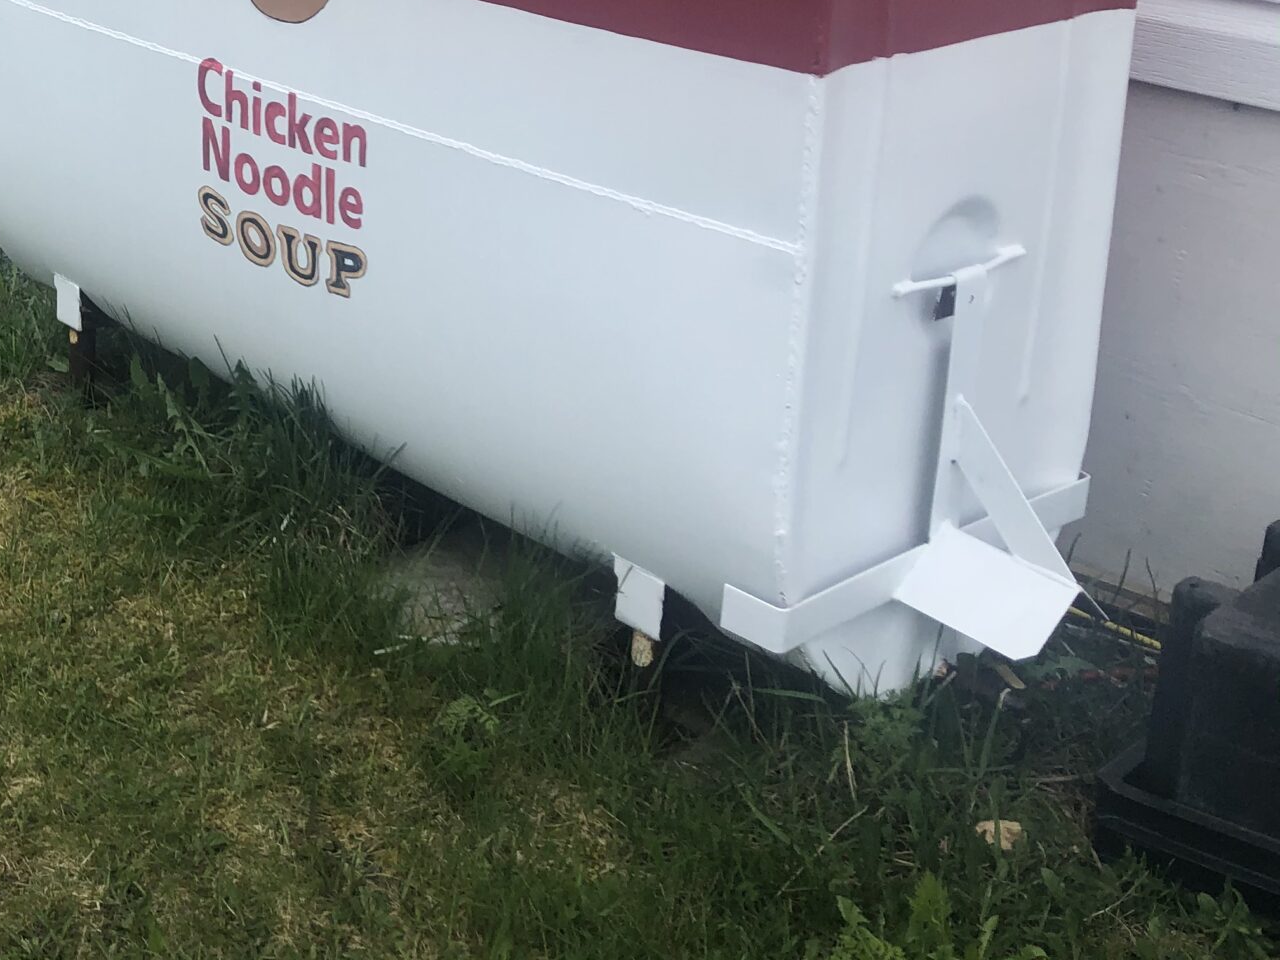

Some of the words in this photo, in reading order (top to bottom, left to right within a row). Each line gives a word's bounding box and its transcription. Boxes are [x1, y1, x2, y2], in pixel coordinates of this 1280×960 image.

[197, 57, 367, 168] Chicken
[202, 116, 364, 230] Noodle
[197, 185, 368, 299] SOUP
